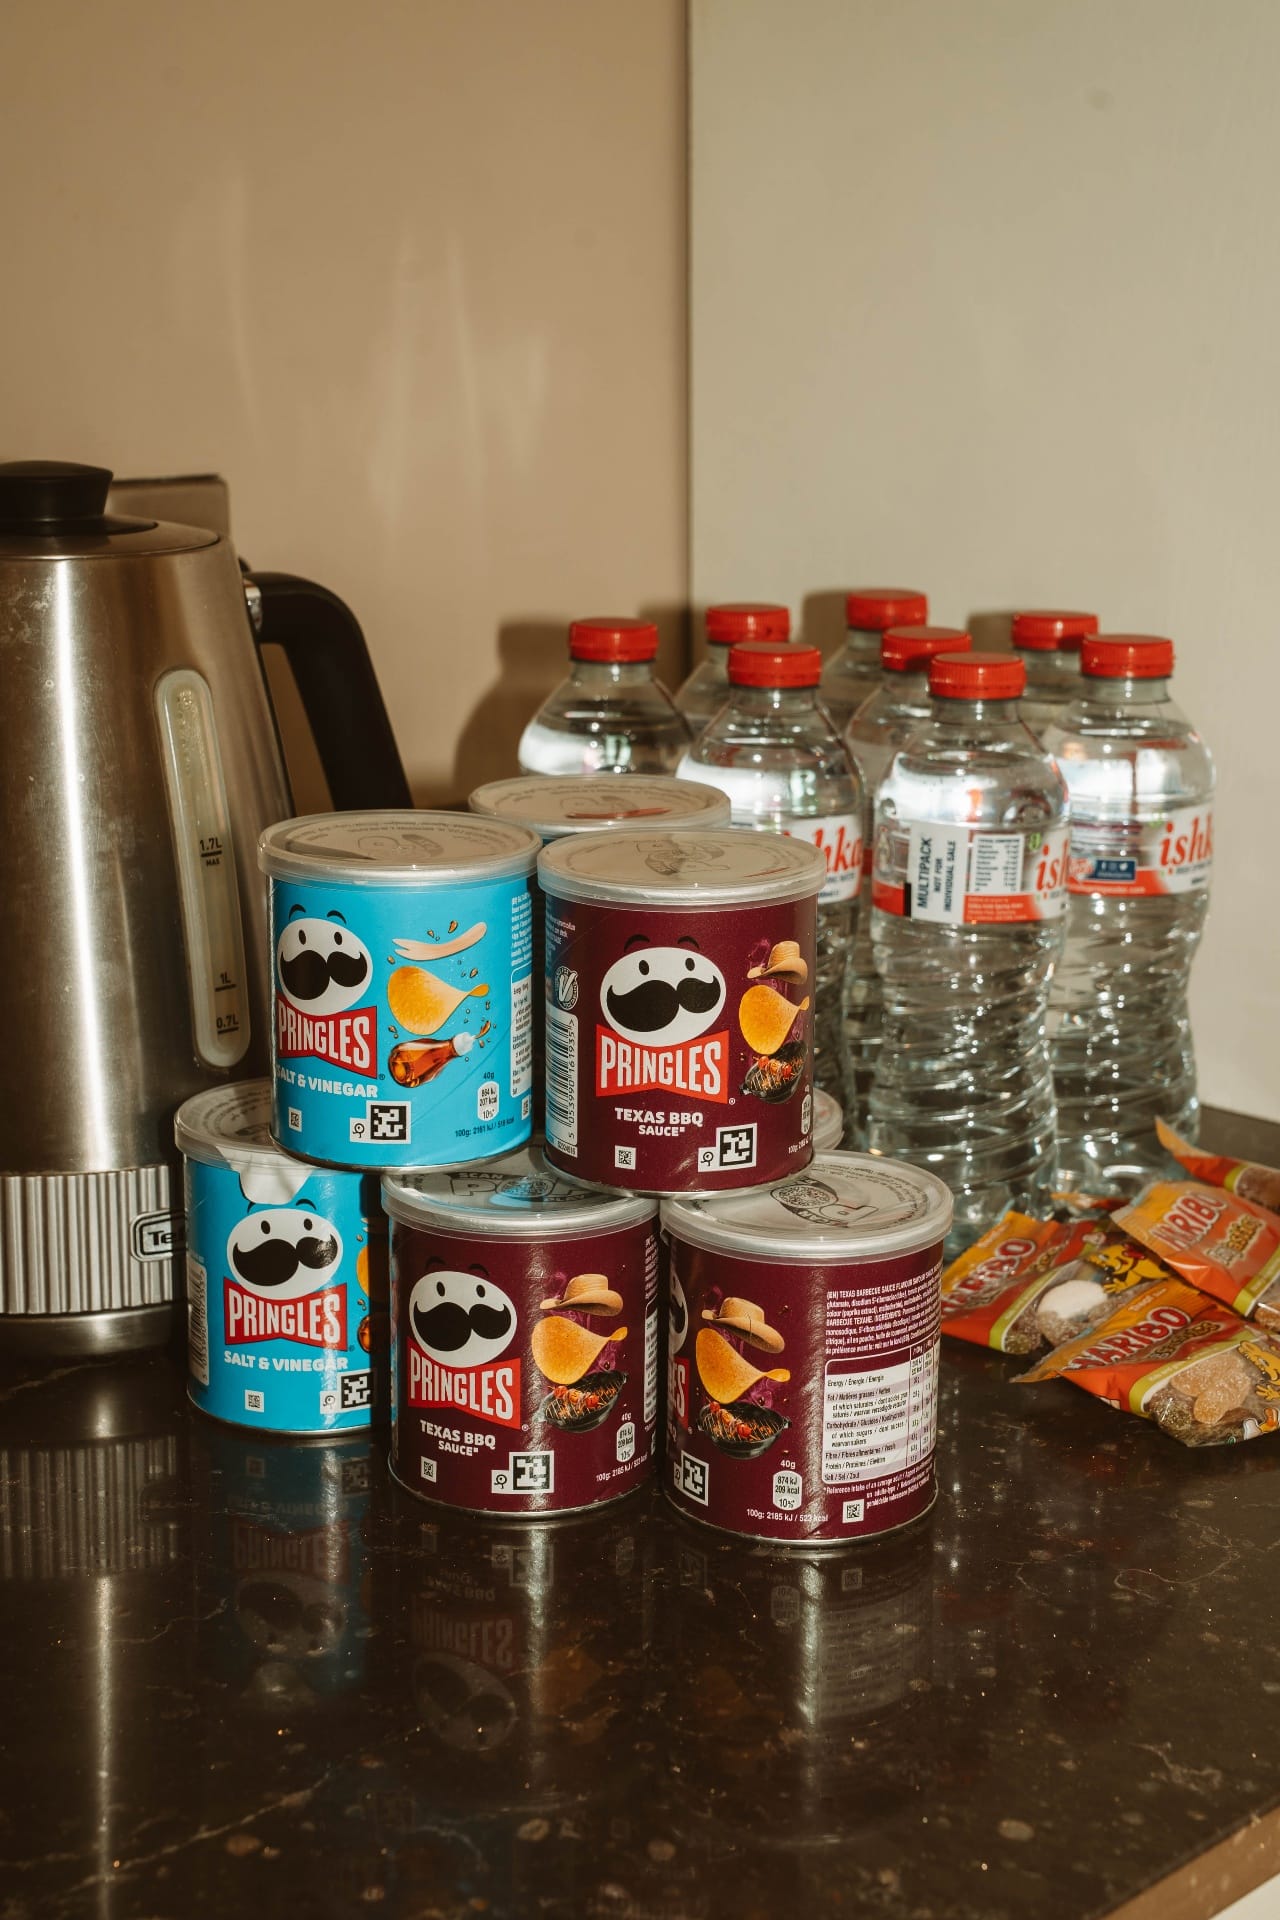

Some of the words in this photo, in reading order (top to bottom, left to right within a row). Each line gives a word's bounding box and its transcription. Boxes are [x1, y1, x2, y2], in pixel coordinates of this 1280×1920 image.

[200, 837, 222, 851] 1.7L
[946, 839, 956, 861] SALE
[917, 837, 932, 909] MULTIPACK
[943, 865, 954, 912] INDIVIDUAL
[220, 972, 232, 984] 1L
[216, 1014, 240, 1029] 0.7L
[278, 1000, 371, 1069] PRINGLES
[600, 1035, 722, 1095] PRINGLES
[297, 1074, 306, 1088] &
[308, 1077, 378, 1098] VINEGAR
[615, 1107, 666, 1124] TEXAS
[669, 1112, 704, 1127] BBQ
[147, 1230, 177, 1246] Te
[228, 1288, 341, 1344] PRINGLES
[224, 1350, 256, 1368] SALT
[258, 1356, 270, 1370] &
[272, 1357, 349, 1373] VINEGAR
[410, 1348, 514, 1420] PRINGLES
[827, 1380, 844, 1388] Energy
[420, 1420, 461, 1442] TEXAS
[464, 1432, 496, 1450] BBQ
[780, 1459, 796, 1470] 40g
[777, 1476, 789, 1485] 874
[789, 1475, 798, 1486] kJ
[786, 1485, 800, 1495] kcal
[746, 1508, 765, 1519] 100g:
[766, 1513, 783, 1521] 2185
[784, 1513, 793, 1522] kJ
